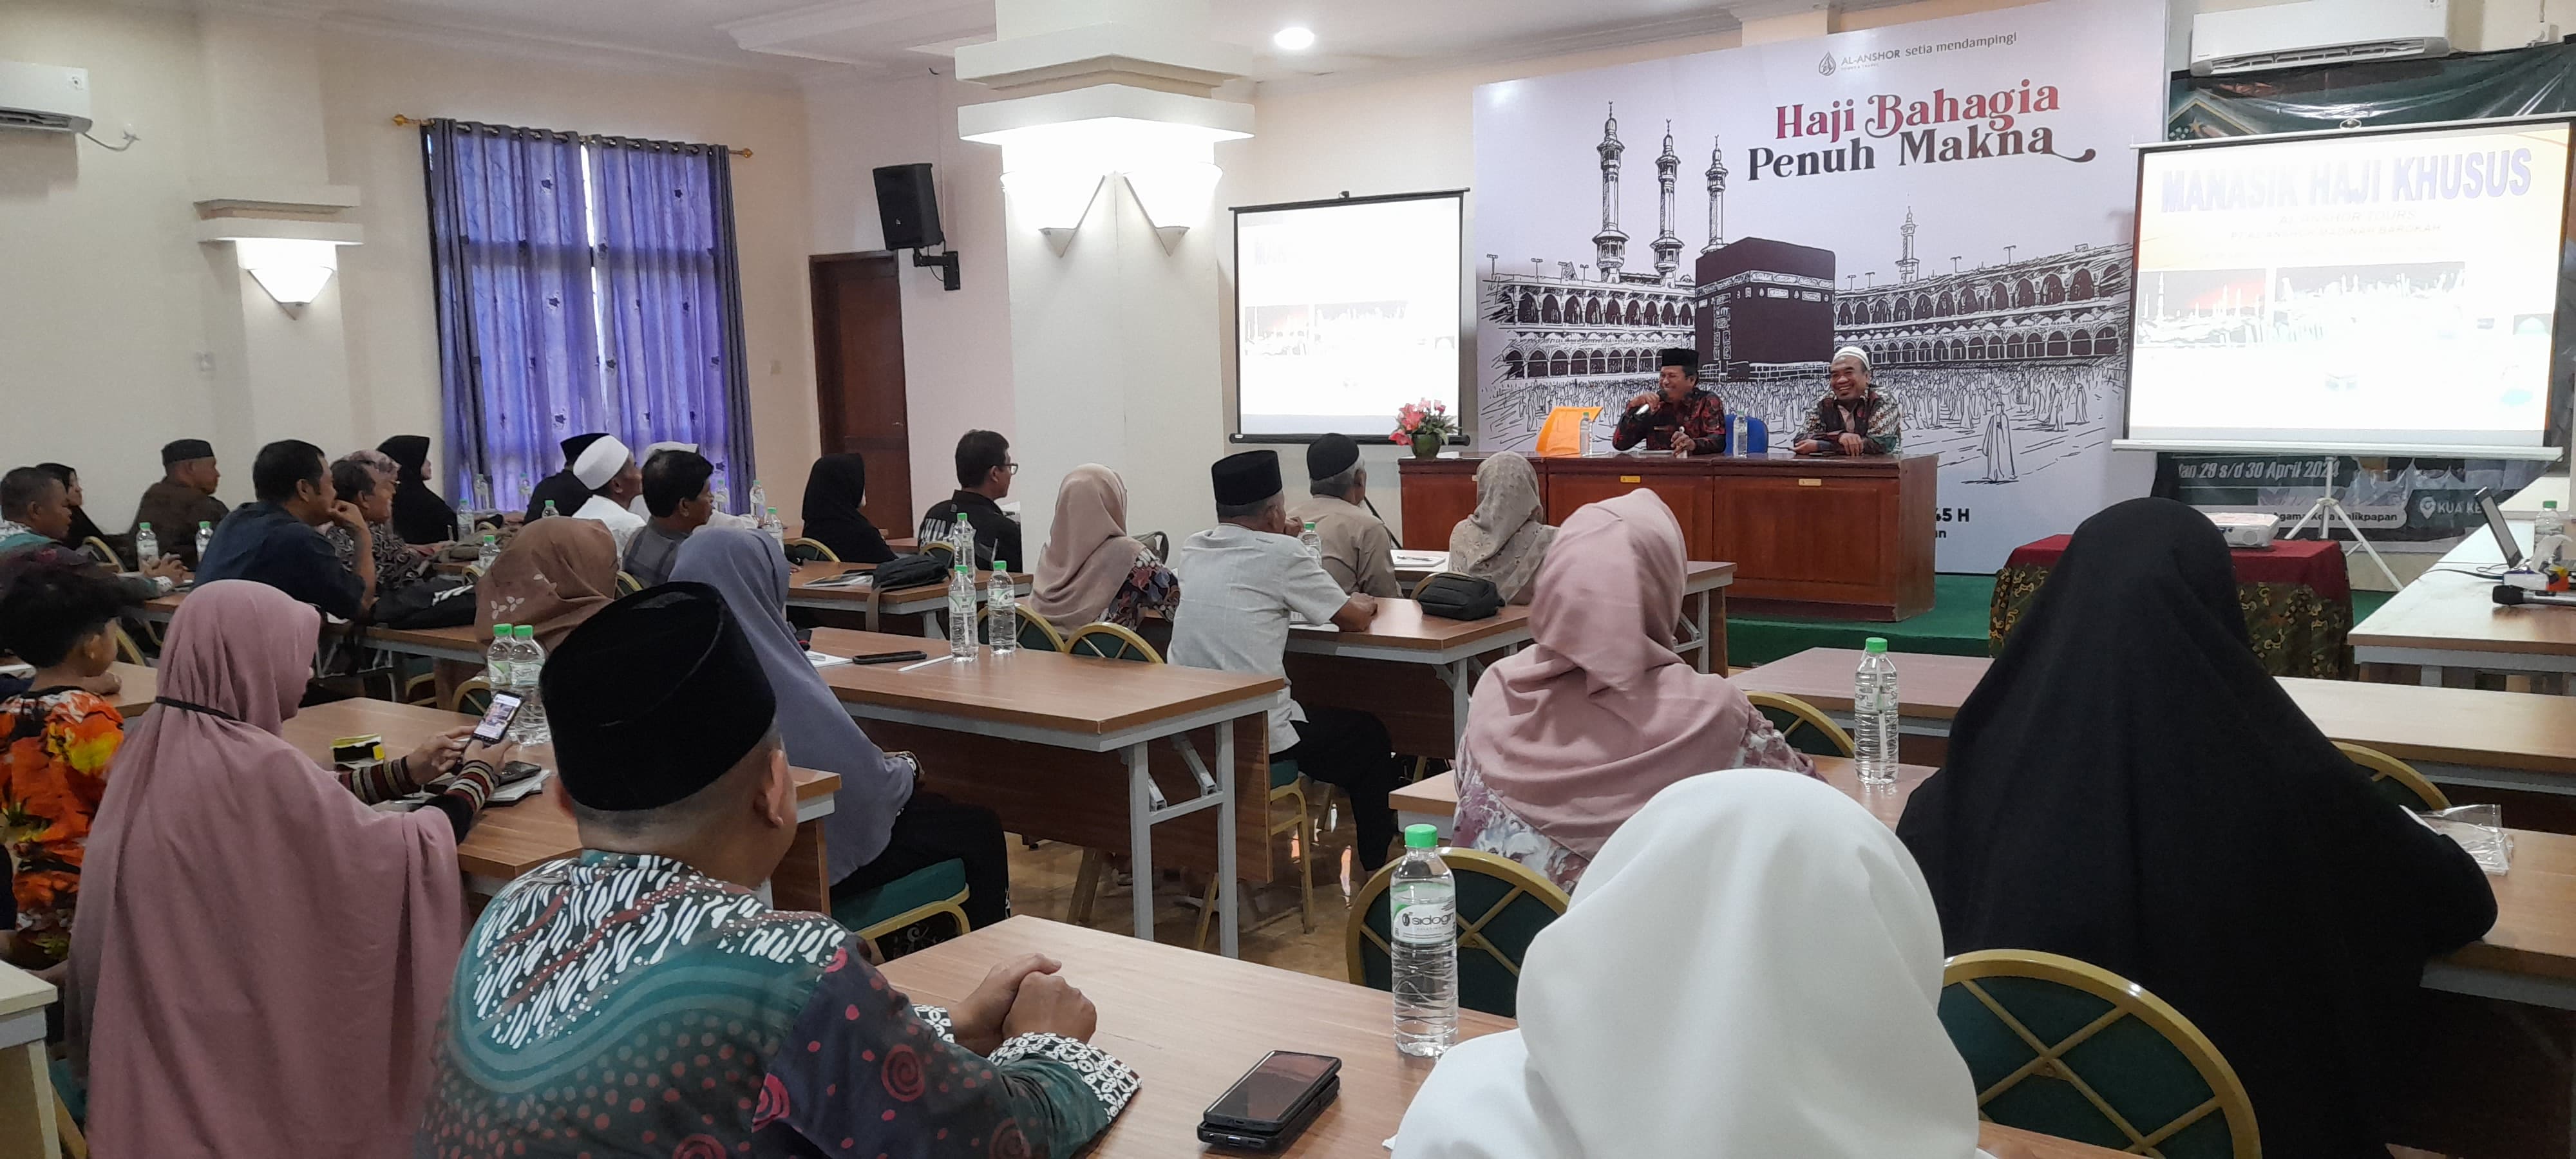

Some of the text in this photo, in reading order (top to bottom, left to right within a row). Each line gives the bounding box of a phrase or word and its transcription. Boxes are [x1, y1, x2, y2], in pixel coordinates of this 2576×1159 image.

[1841, 32, 2016, 66] AL-ANSHOR setia mendampingi
[1776, 79, 2060, 143] Haji Bahagia
[1748, 124, 2096, 181] Penuh Makna
[2161, 148, 2532, 213] MANASIK HAJI KHUSUS
[2219, 462, 2244, 478] s/d
[2245, 462, 2265, 478] 30
[2266, 461, 2303, 480] April
[1958, 508, 1969, 522] H
[2438, 501, 2463, 514] KUA
